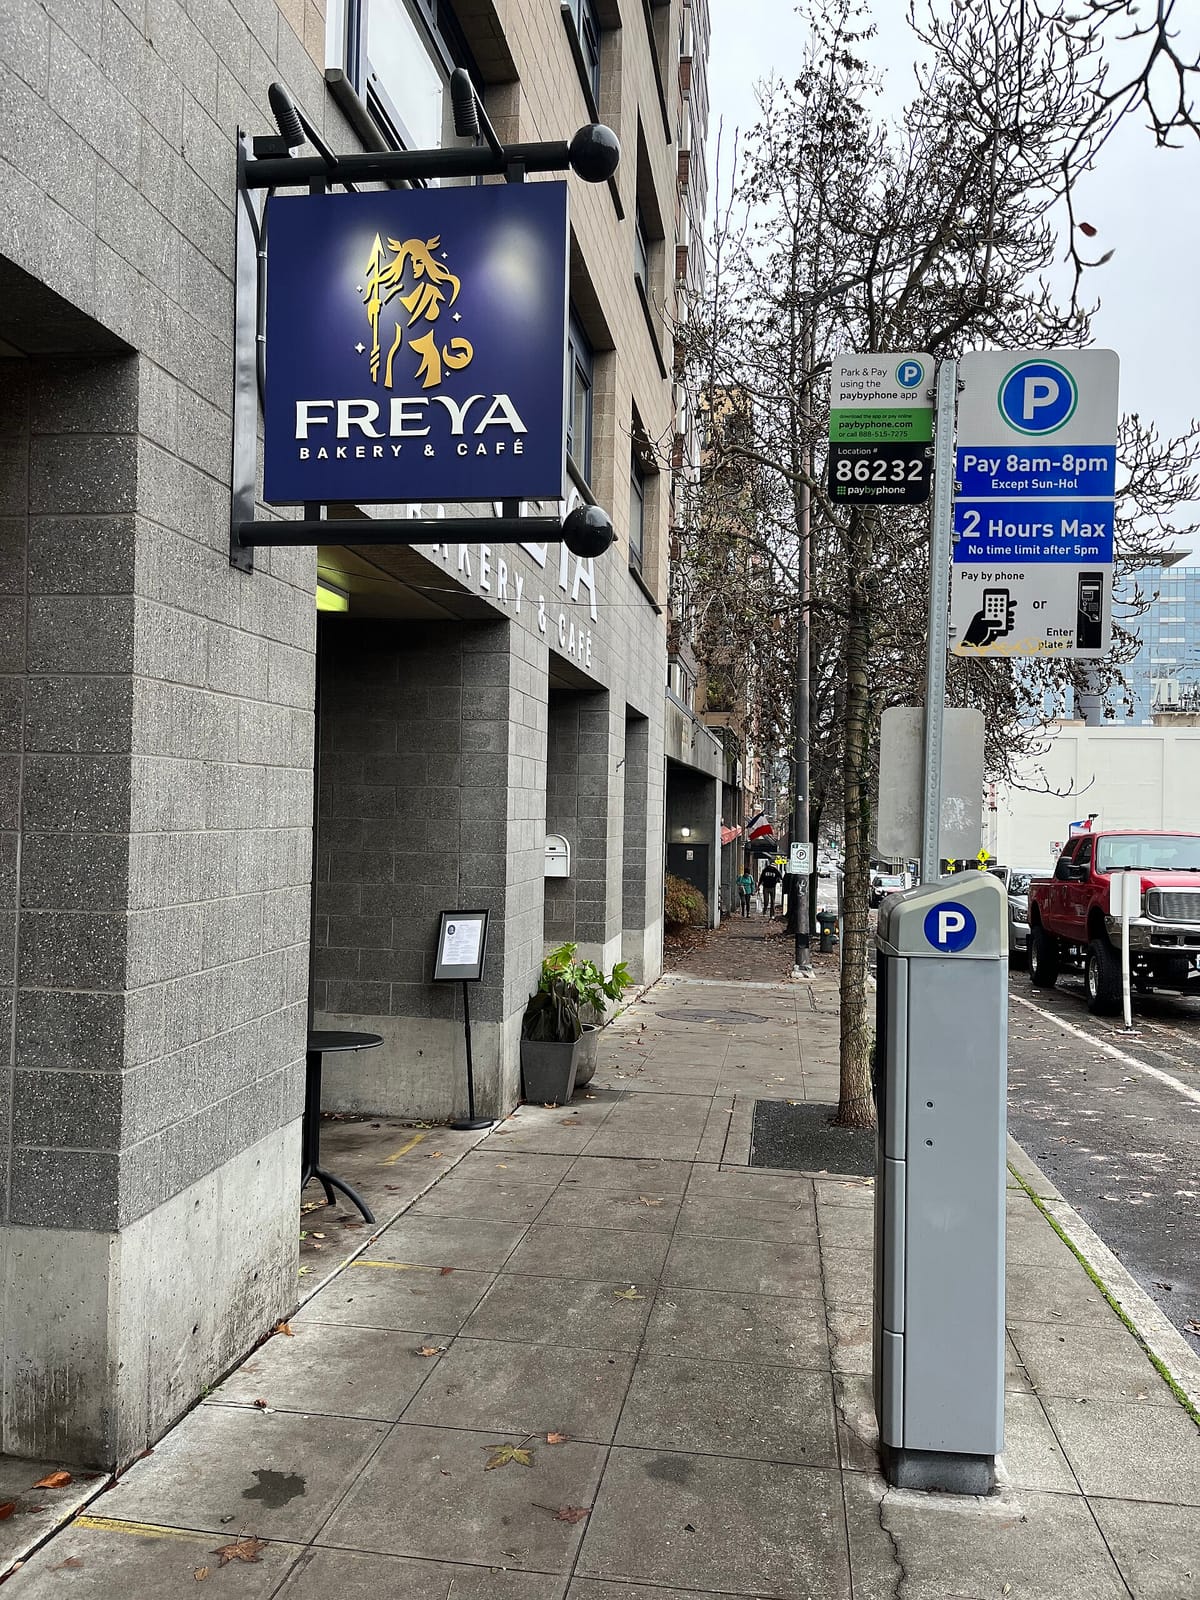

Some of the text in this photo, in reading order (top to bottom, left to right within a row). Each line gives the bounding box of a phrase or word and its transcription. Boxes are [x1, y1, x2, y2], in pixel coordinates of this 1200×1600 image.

[840, 368, 888, 378] Park & Pay
[904, 366, 917, 382] P
[840, 379, 881, 389] using the
[840, 391, 918, 400] paybyphone app
[1023, 376, 1060, 420] P
[295, 394, 528, 439] FREYA
[839, 420, 913, 430] paybyphone.com
[858, 430, 908, 438] 888-515-7275
[300, 438, 524, 460] BAKERY & CAFÉ
[837, 447, 872, 455] Location
[836, 459, 923, 481] 86232
[963, 453, 1108, 477] Pay 8am-8pm
[847, 485, 906, 496] paybyphone
[991, 478, 1078, 491] Except Sun-Hol
[962, 510, 1106, 538] 2 Hours Max
[968, 544, 1099, 558] No time limit after 5pm
[961, 571, 1025, 583] Pay by phone
[1032, 600, 1048, 609] or
[1046, 627, 1074, 637] Enter
[558, 613, 593, 669] CAFÉ
[1038, 640, 1073, 650] plate #
[938, 911, 966, 944] P
